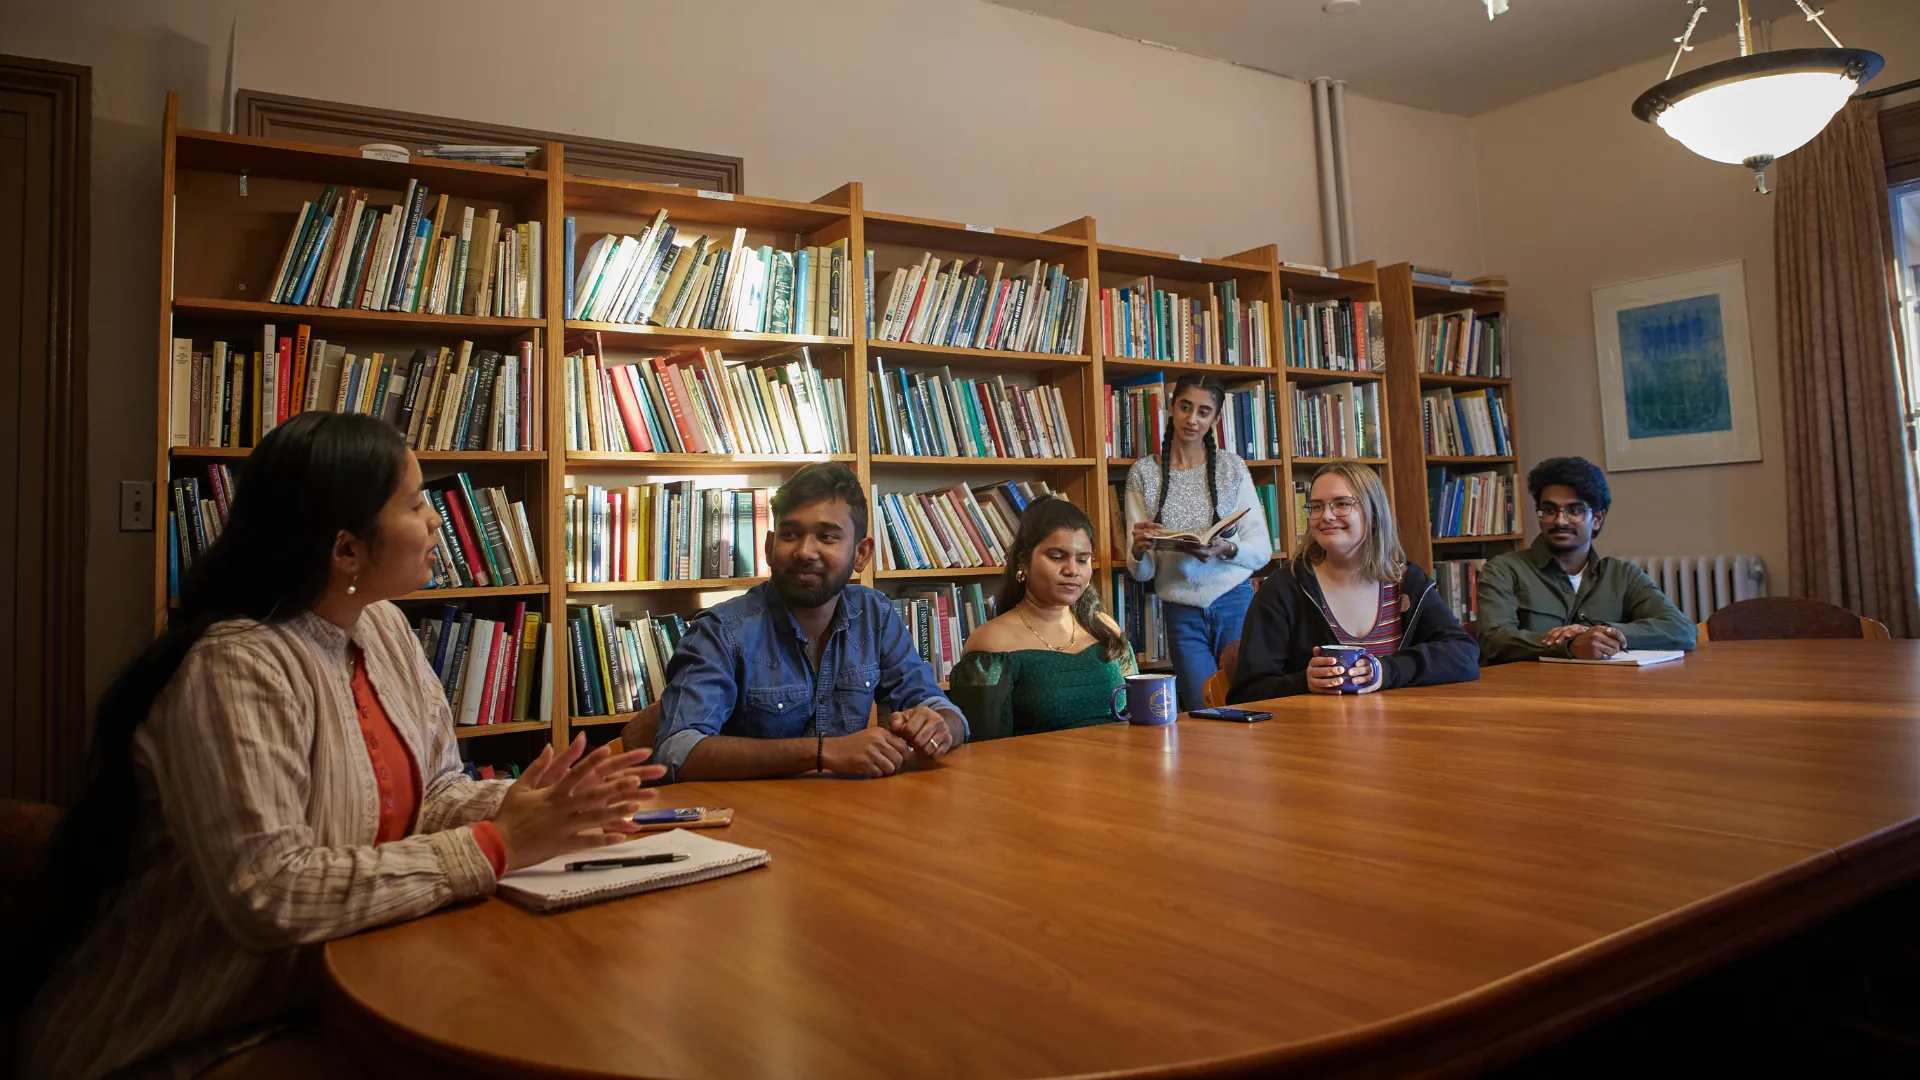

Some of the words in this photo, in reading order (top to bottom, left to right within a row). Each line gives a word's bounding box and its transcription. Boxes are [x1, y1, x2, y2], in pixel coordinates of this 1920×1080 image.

[298, 335, 306, 355] IRON
[438, 505, 454, 534] VILLAGE
[448, 533, 465, 565] JOURNEY
[608, 644, 617, 664] Settler's
[611, 665, 620, 685] Dream
